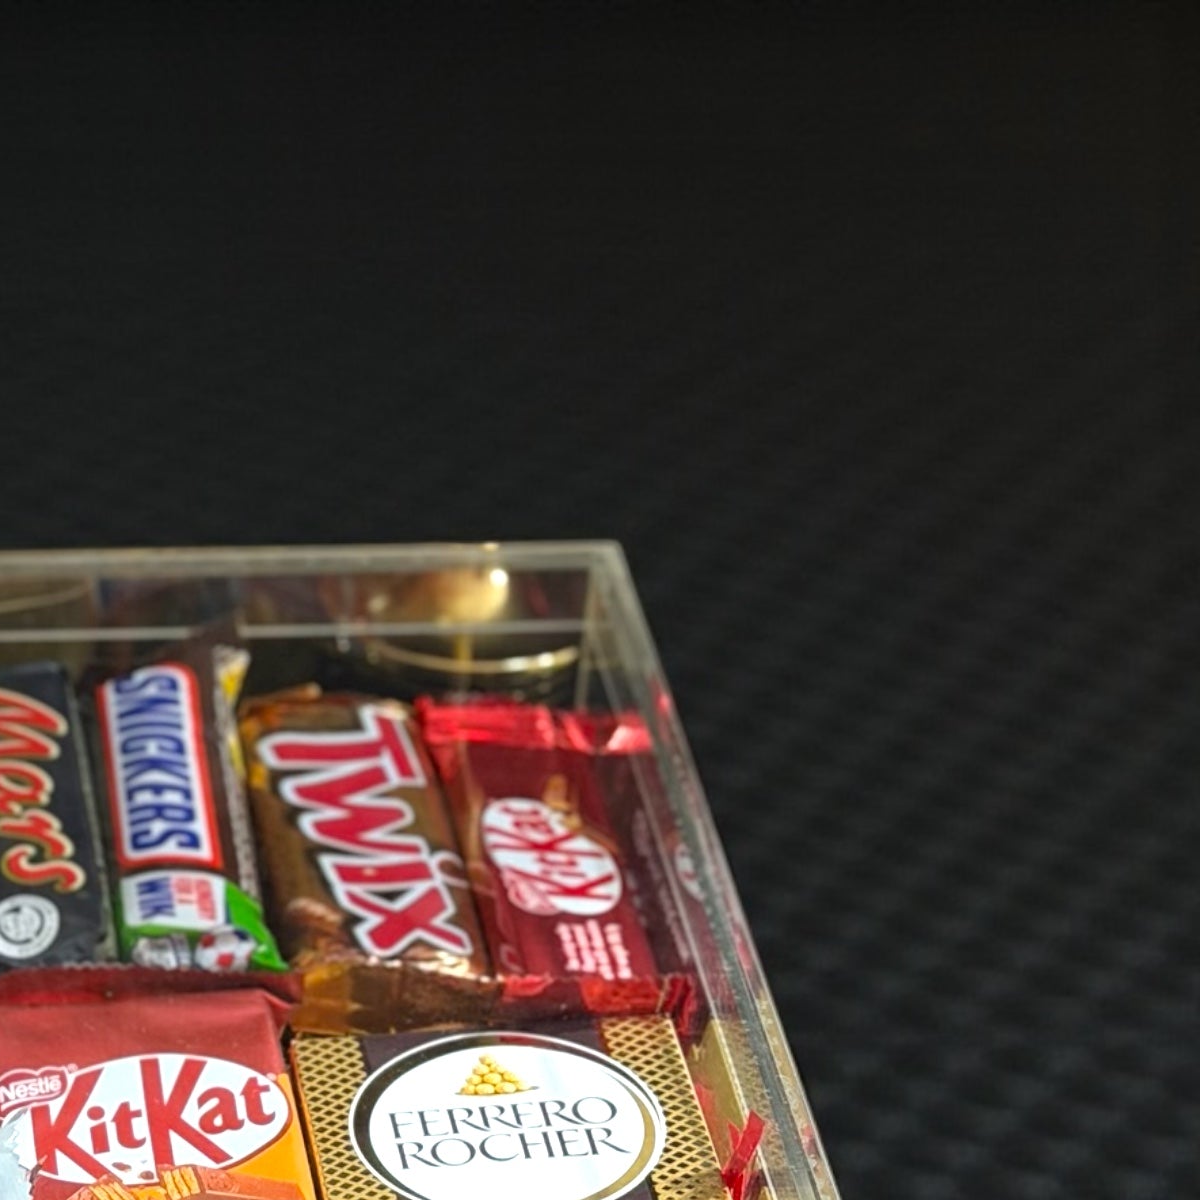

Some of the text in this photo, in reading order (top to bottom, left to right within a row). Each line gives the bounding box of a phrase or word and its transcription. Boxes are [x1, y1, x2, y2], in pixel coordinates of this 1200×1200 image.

[114, 673, 200, 854] SNICKERS
[257, 702, 472, 957] TWIX
[30, 1058, 276, 1182] KitKat
[389, 1096, 618, 1141] FERRERO
[395, 1126, 632, 1170] ROCHER
